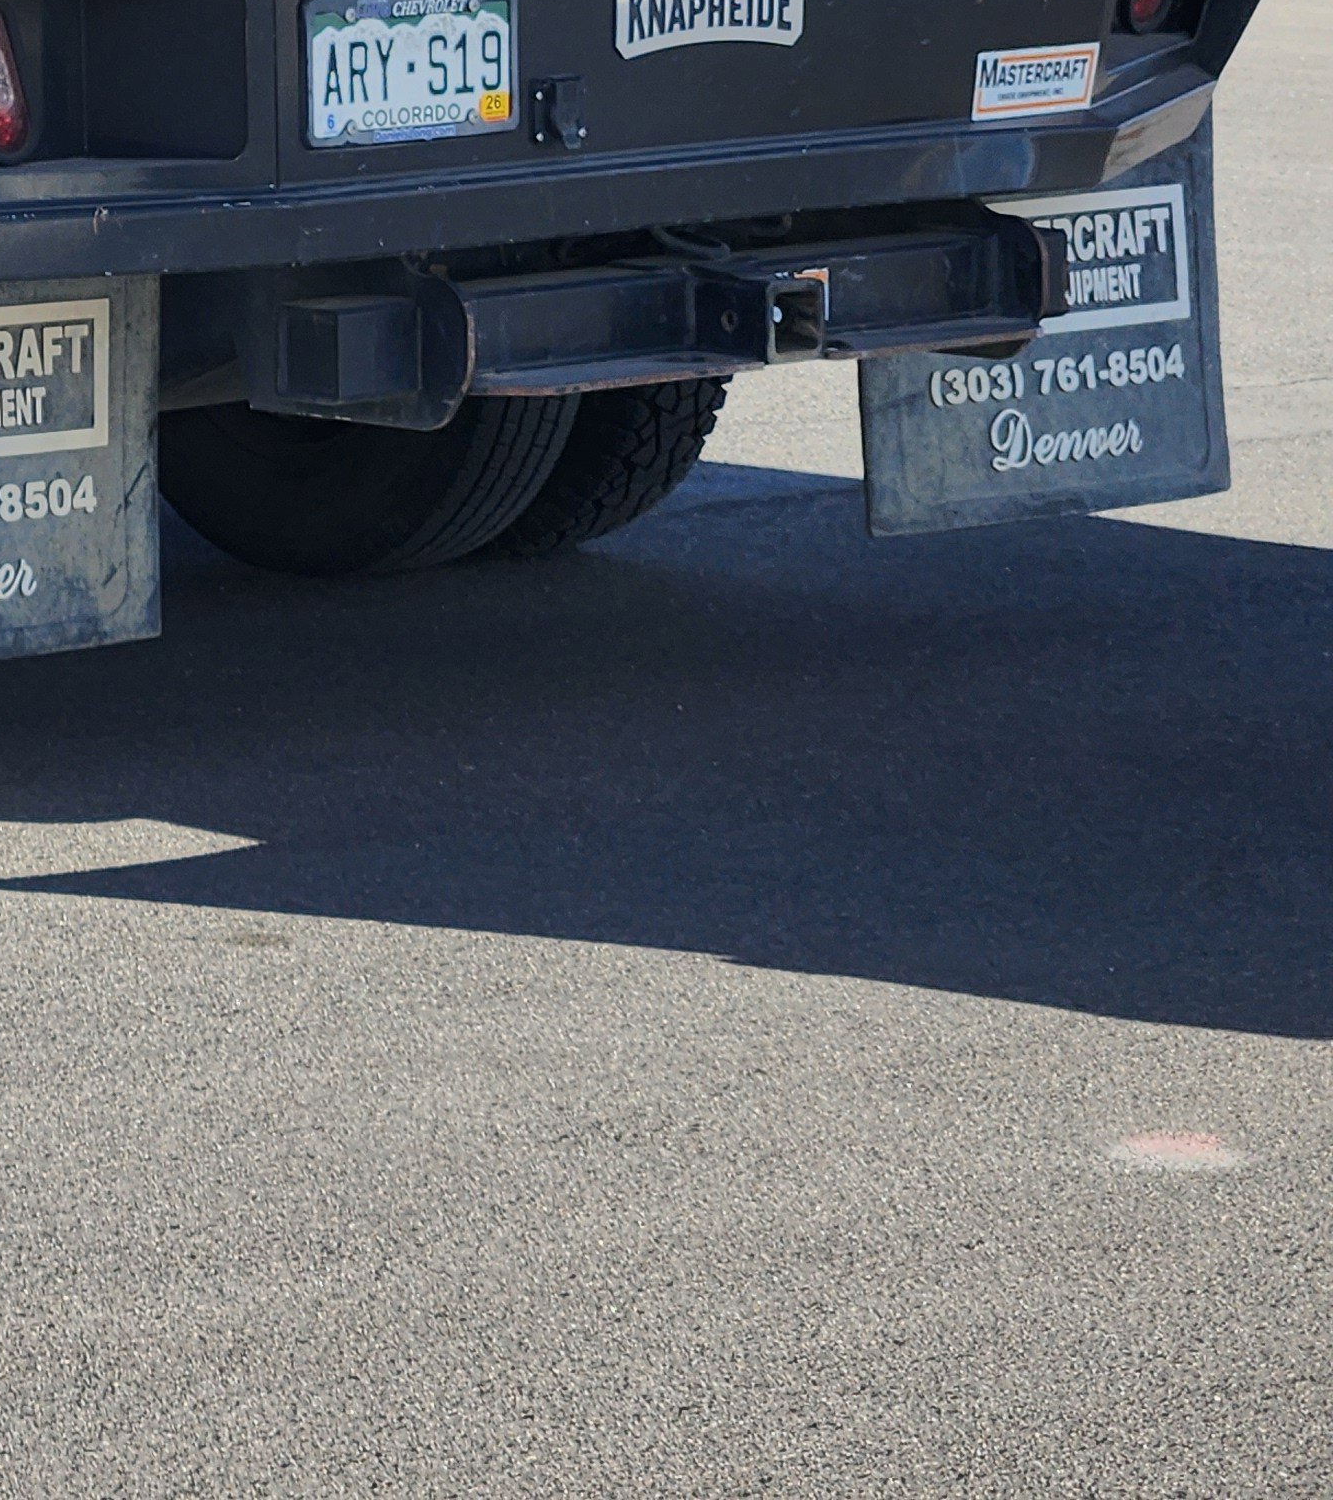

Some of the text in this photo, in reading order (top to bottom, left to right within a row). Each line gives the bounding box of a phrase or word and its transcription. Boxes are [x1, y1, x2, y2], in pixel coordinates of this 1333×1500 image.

[323, 37, 395, 107] ARY
[979, 57, 1089, 89] MASTERCRAFT
[362, 102, 462, 128] COLORADO
[485, 94, 502, 111] 26
[326, 114, 336, 130] 6
[929, 344, 1185, 409] (303) 761-8504
[990, 407, 1144, 473] Denver
